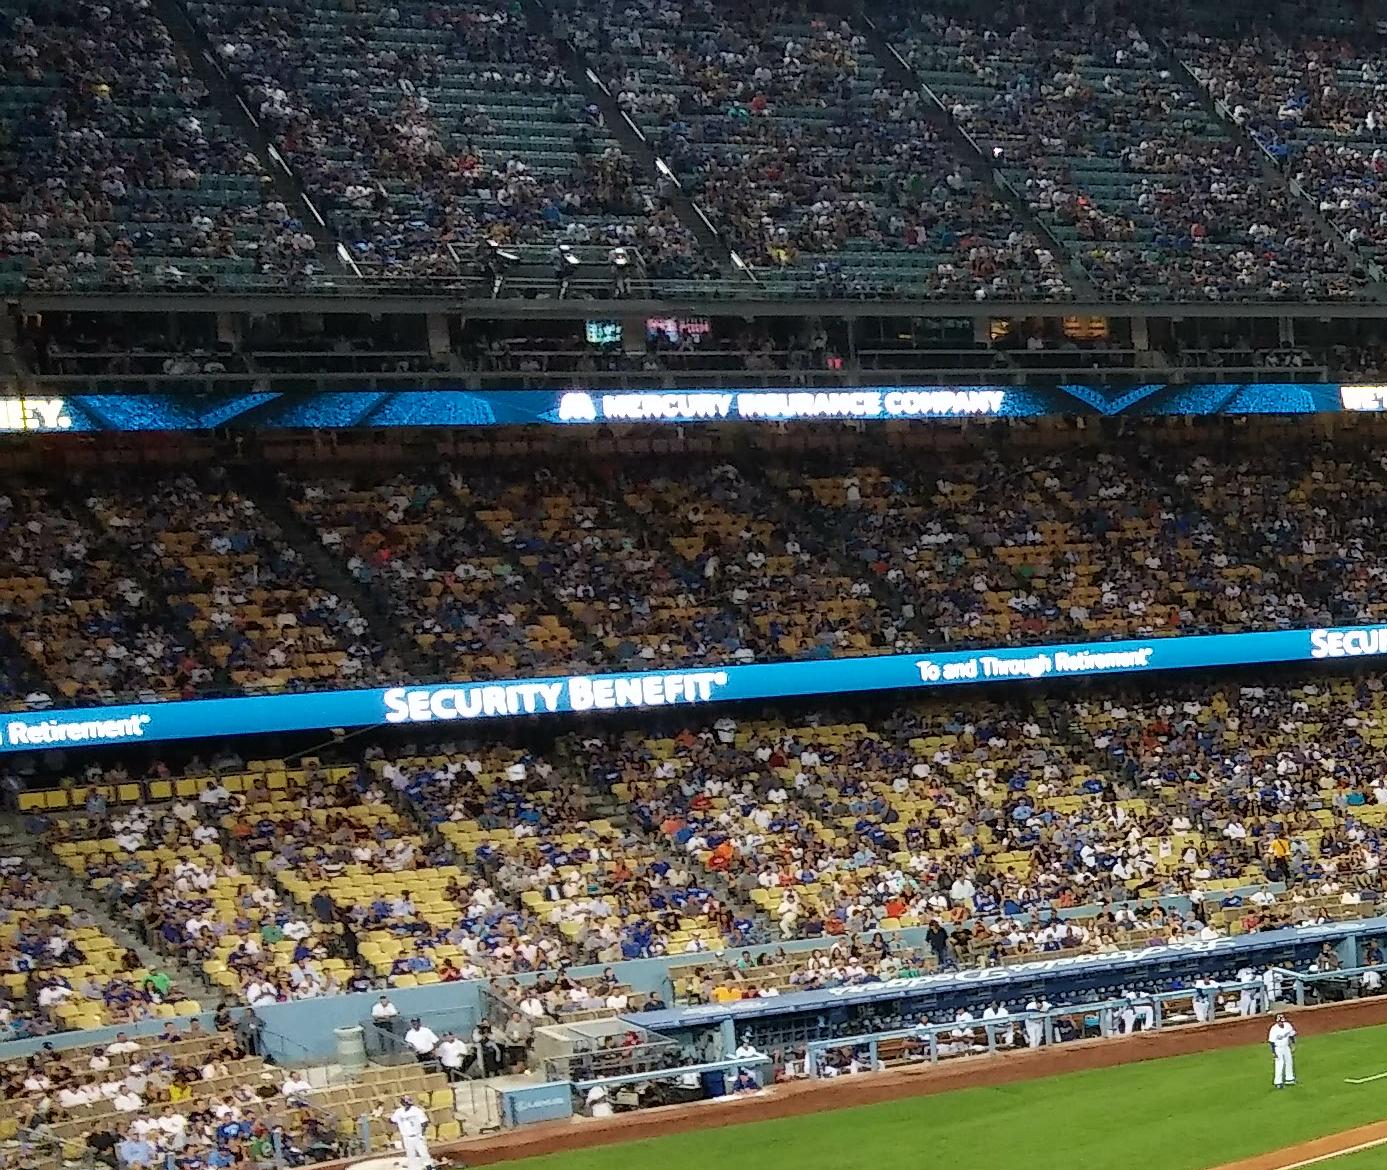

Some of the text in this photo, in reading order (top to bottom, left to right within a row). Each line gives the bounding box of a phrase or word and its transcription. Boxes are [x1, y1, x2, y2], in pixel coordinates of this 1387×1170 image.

[884, 390, 1005, 416] COMPANY
[919, 660, 941, 682] To
[942, 656, 977, 680] and
[980, 652, 1052, 680] Through
[385, 681, 564, 723] SECURITY
